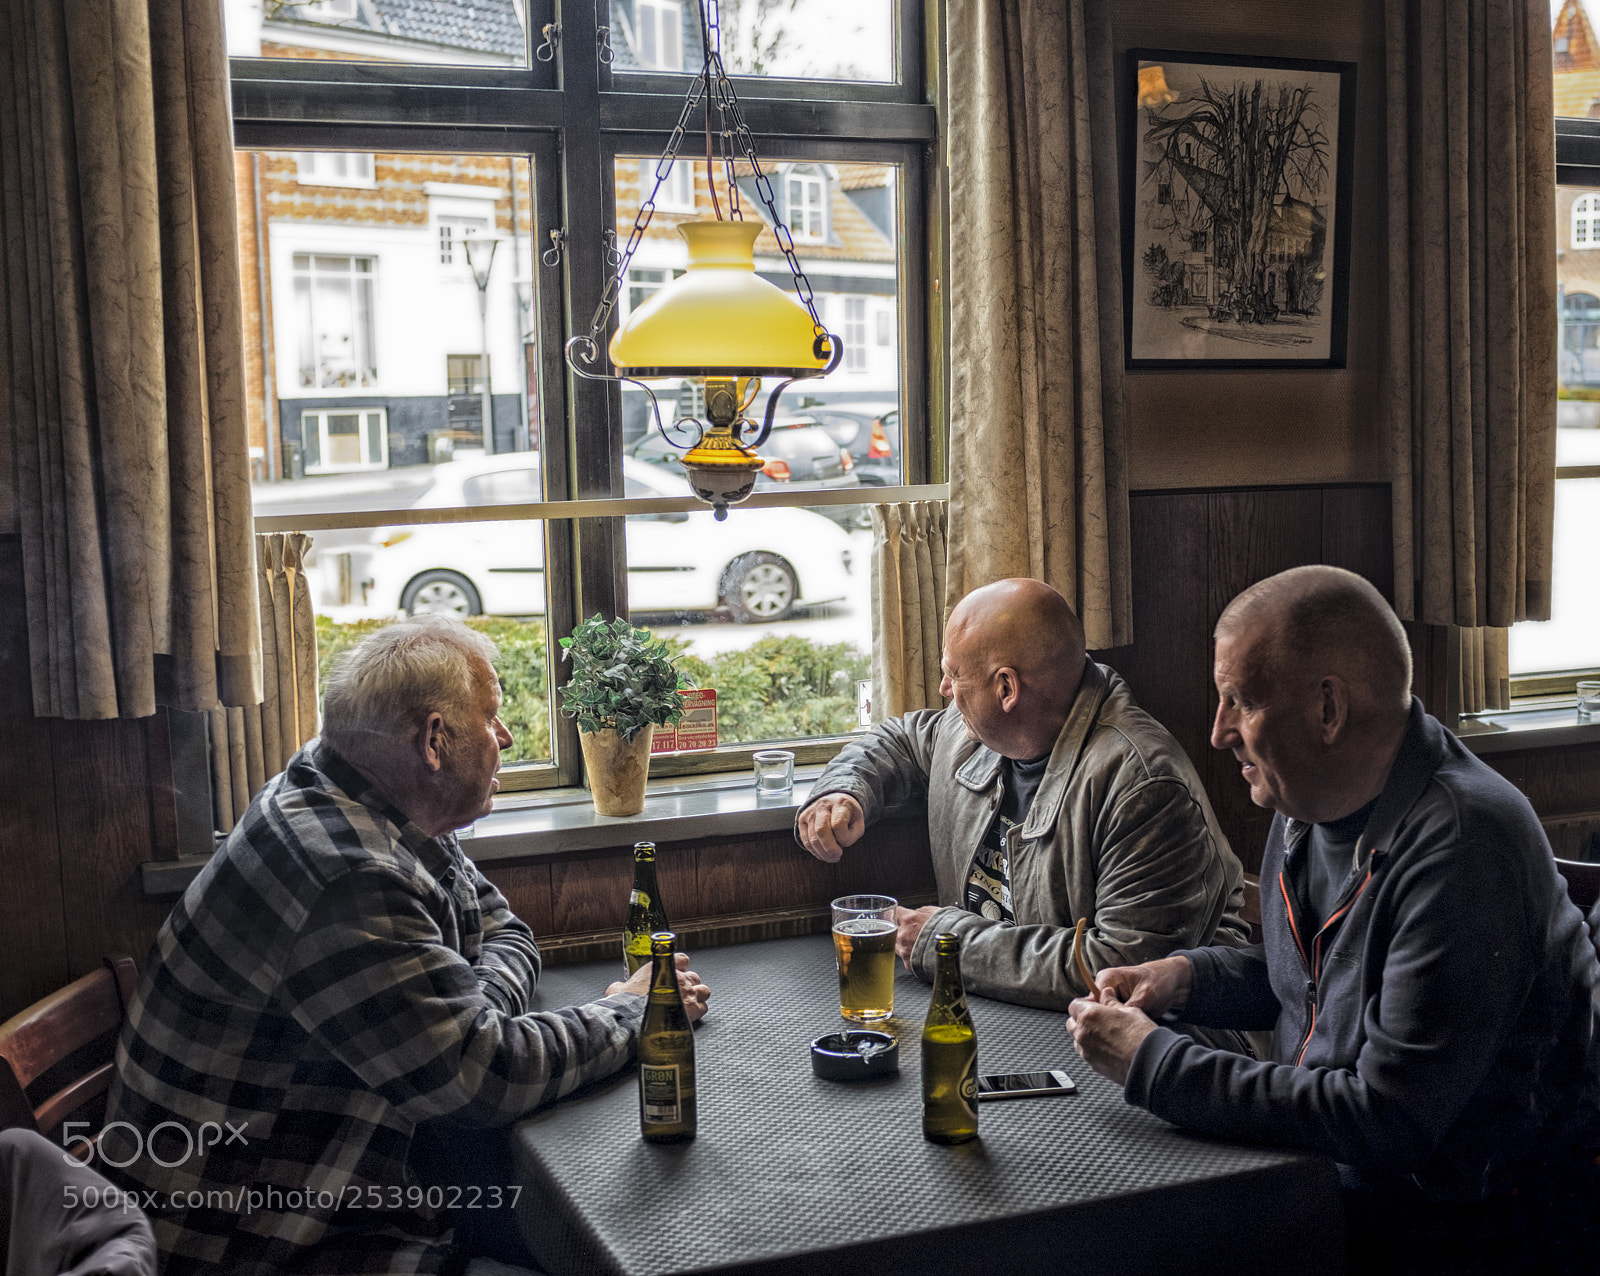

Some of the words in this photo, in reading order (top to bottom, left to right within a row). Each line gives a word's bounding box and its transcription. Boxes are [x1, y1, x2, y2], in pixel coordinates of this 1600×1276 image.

[678, 741, 687, 749] 70
[688, 740, 697, 748] 70
[698, 739, 707, 747] 20
[645, 1070, 674, 1082] GRØN
